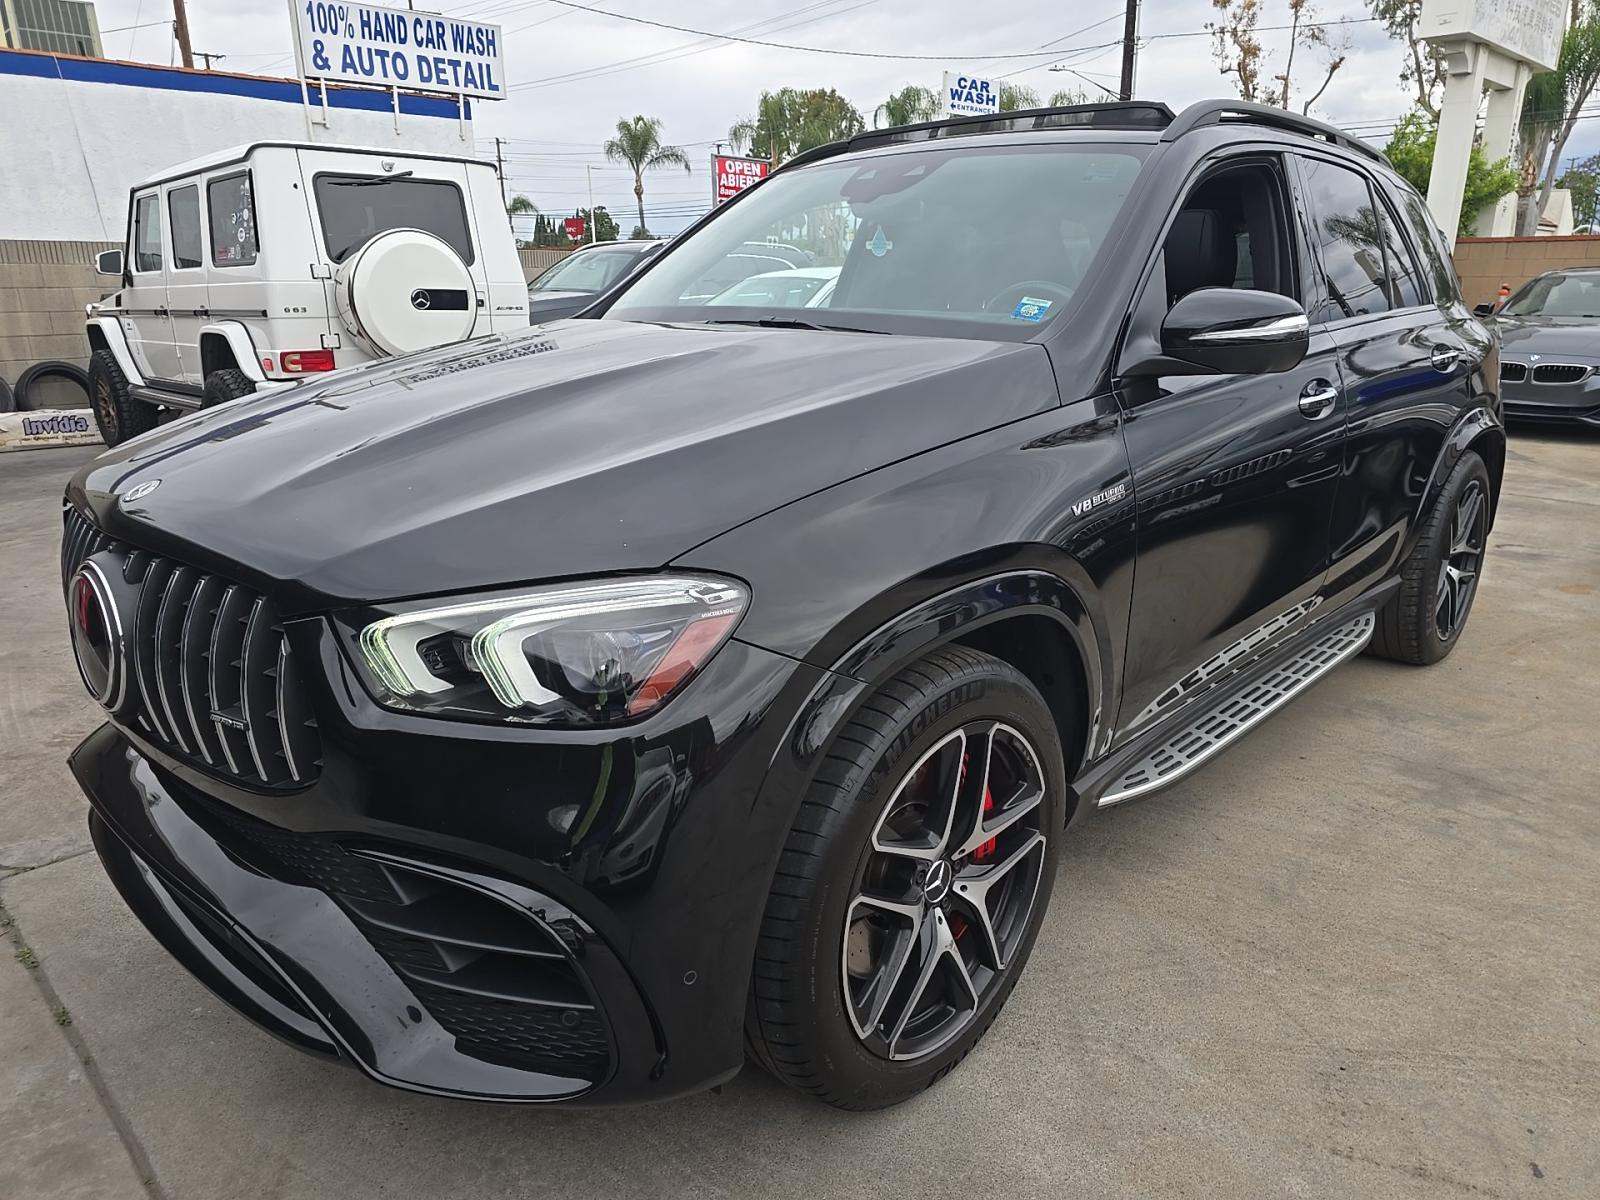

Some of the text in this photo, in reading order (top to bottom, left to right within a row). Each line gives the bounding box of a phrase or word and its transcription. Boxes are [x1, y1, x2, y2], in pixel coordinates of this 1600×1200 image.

[306, 1, 497, 58] 100% HAND CAR WASH
[312, 39, 500, 92] & AUTO DETAIL
[950, 77, 996, 107] CAR WASH
[725, 160, 760, 176] OPEN
[720, 173, 760, 189] ABIERT
[22, 415, 89, 436] Invidia
[1071, 498, 1093, 516] V8
